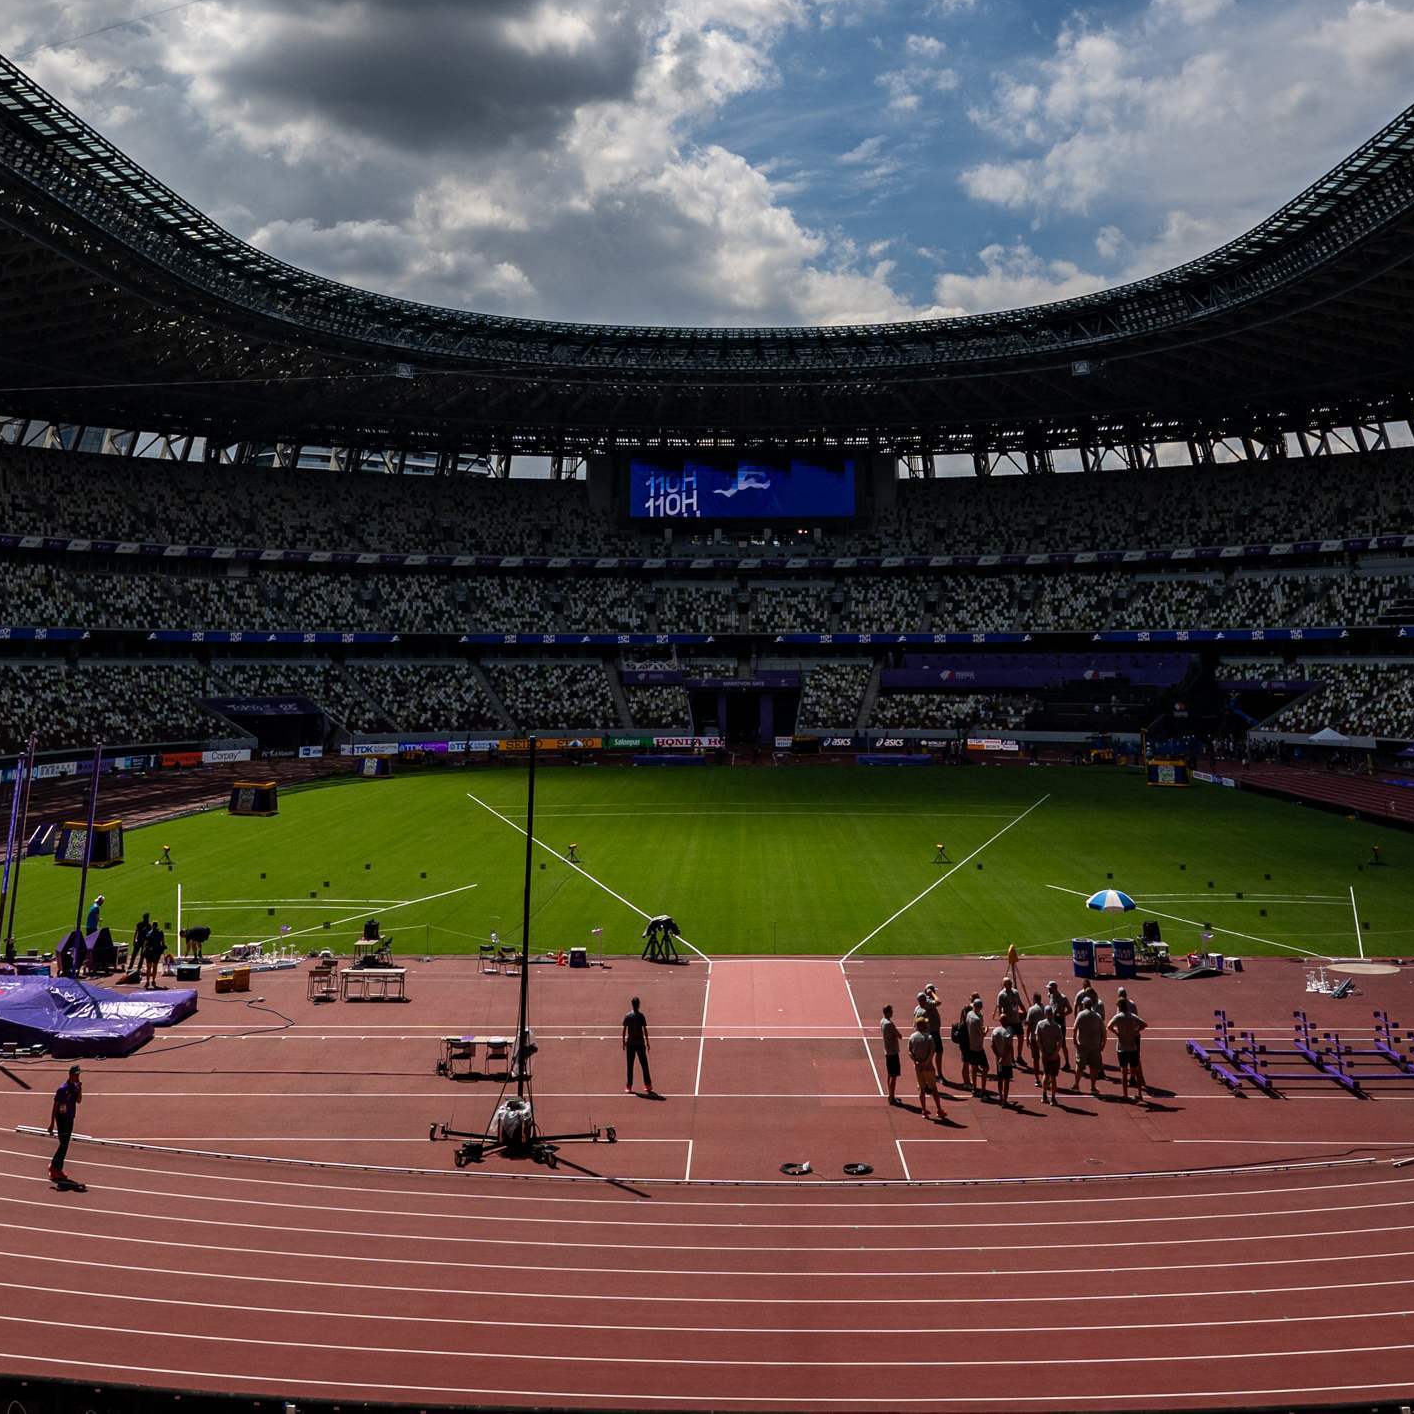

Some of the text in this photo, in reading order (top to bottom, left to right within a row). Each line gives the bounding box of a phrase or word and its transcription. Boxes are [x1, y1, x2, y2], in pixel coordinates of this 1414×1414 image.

[645, 490, 698, 518] 110H
[356, 745, 374, 754] TDK
[403, 743, 423, 752] TDK
[506, 740, 543, 750] SEIO
[211, 751, 242, 763] Corpay
